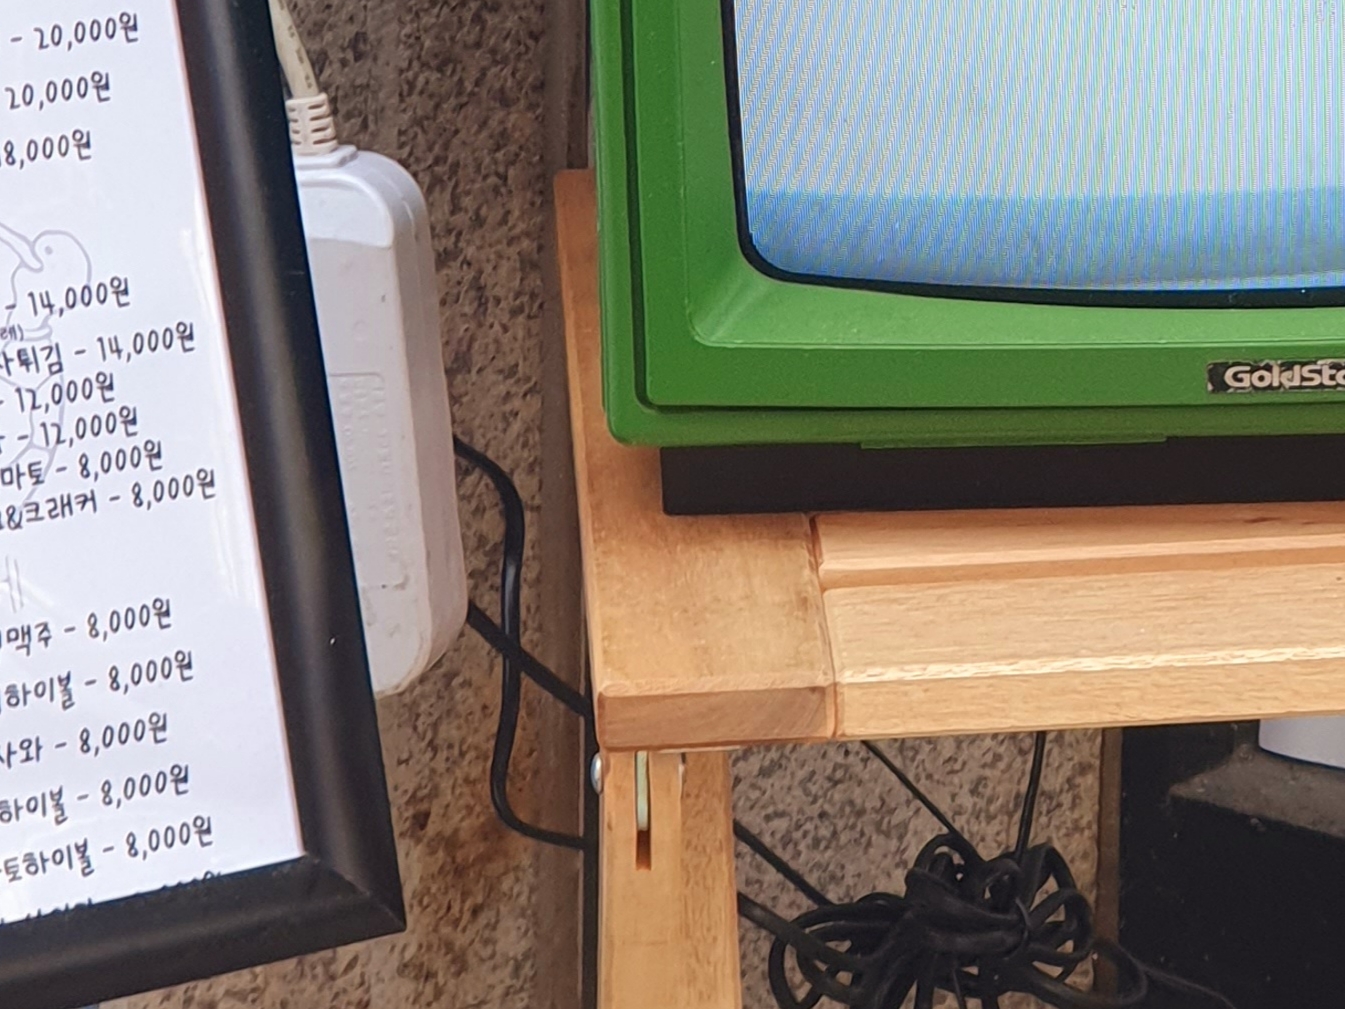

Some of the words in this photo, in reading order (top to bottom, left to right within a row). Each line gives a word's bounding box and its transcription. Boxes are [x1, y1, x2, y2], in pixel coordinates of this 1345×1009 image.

[33, 11, 139, 52] 20,000원
[5, 70, 111, 111] 20,000원
[0, 128, 92, 170] 8,000원
[27, 275, 130, 318] 14,000원
[96, 320, 196, 363] 14,000원
[15, 371, 115, 414] 12,000원
[40, 404, 138, 448] 12,000원
[0, 461, 45, 490] 마토
[78, 438, 163, 482] 8,000원
[0, 489, 97, 531] &크래커
[131, 468, 216, 511] 8,000원
[0, 621, 52, 657] 맥주
[87, 597, 172, 642] 8,000원
[108, 649, 194, 695] 8,000원
[79, 711, 168, 758] 8,000원
[100, 763, 189, 809] 8,000원
[0, 837, 95, 883] 토하이볼
[126, 814, 213, 861] 8,000원
